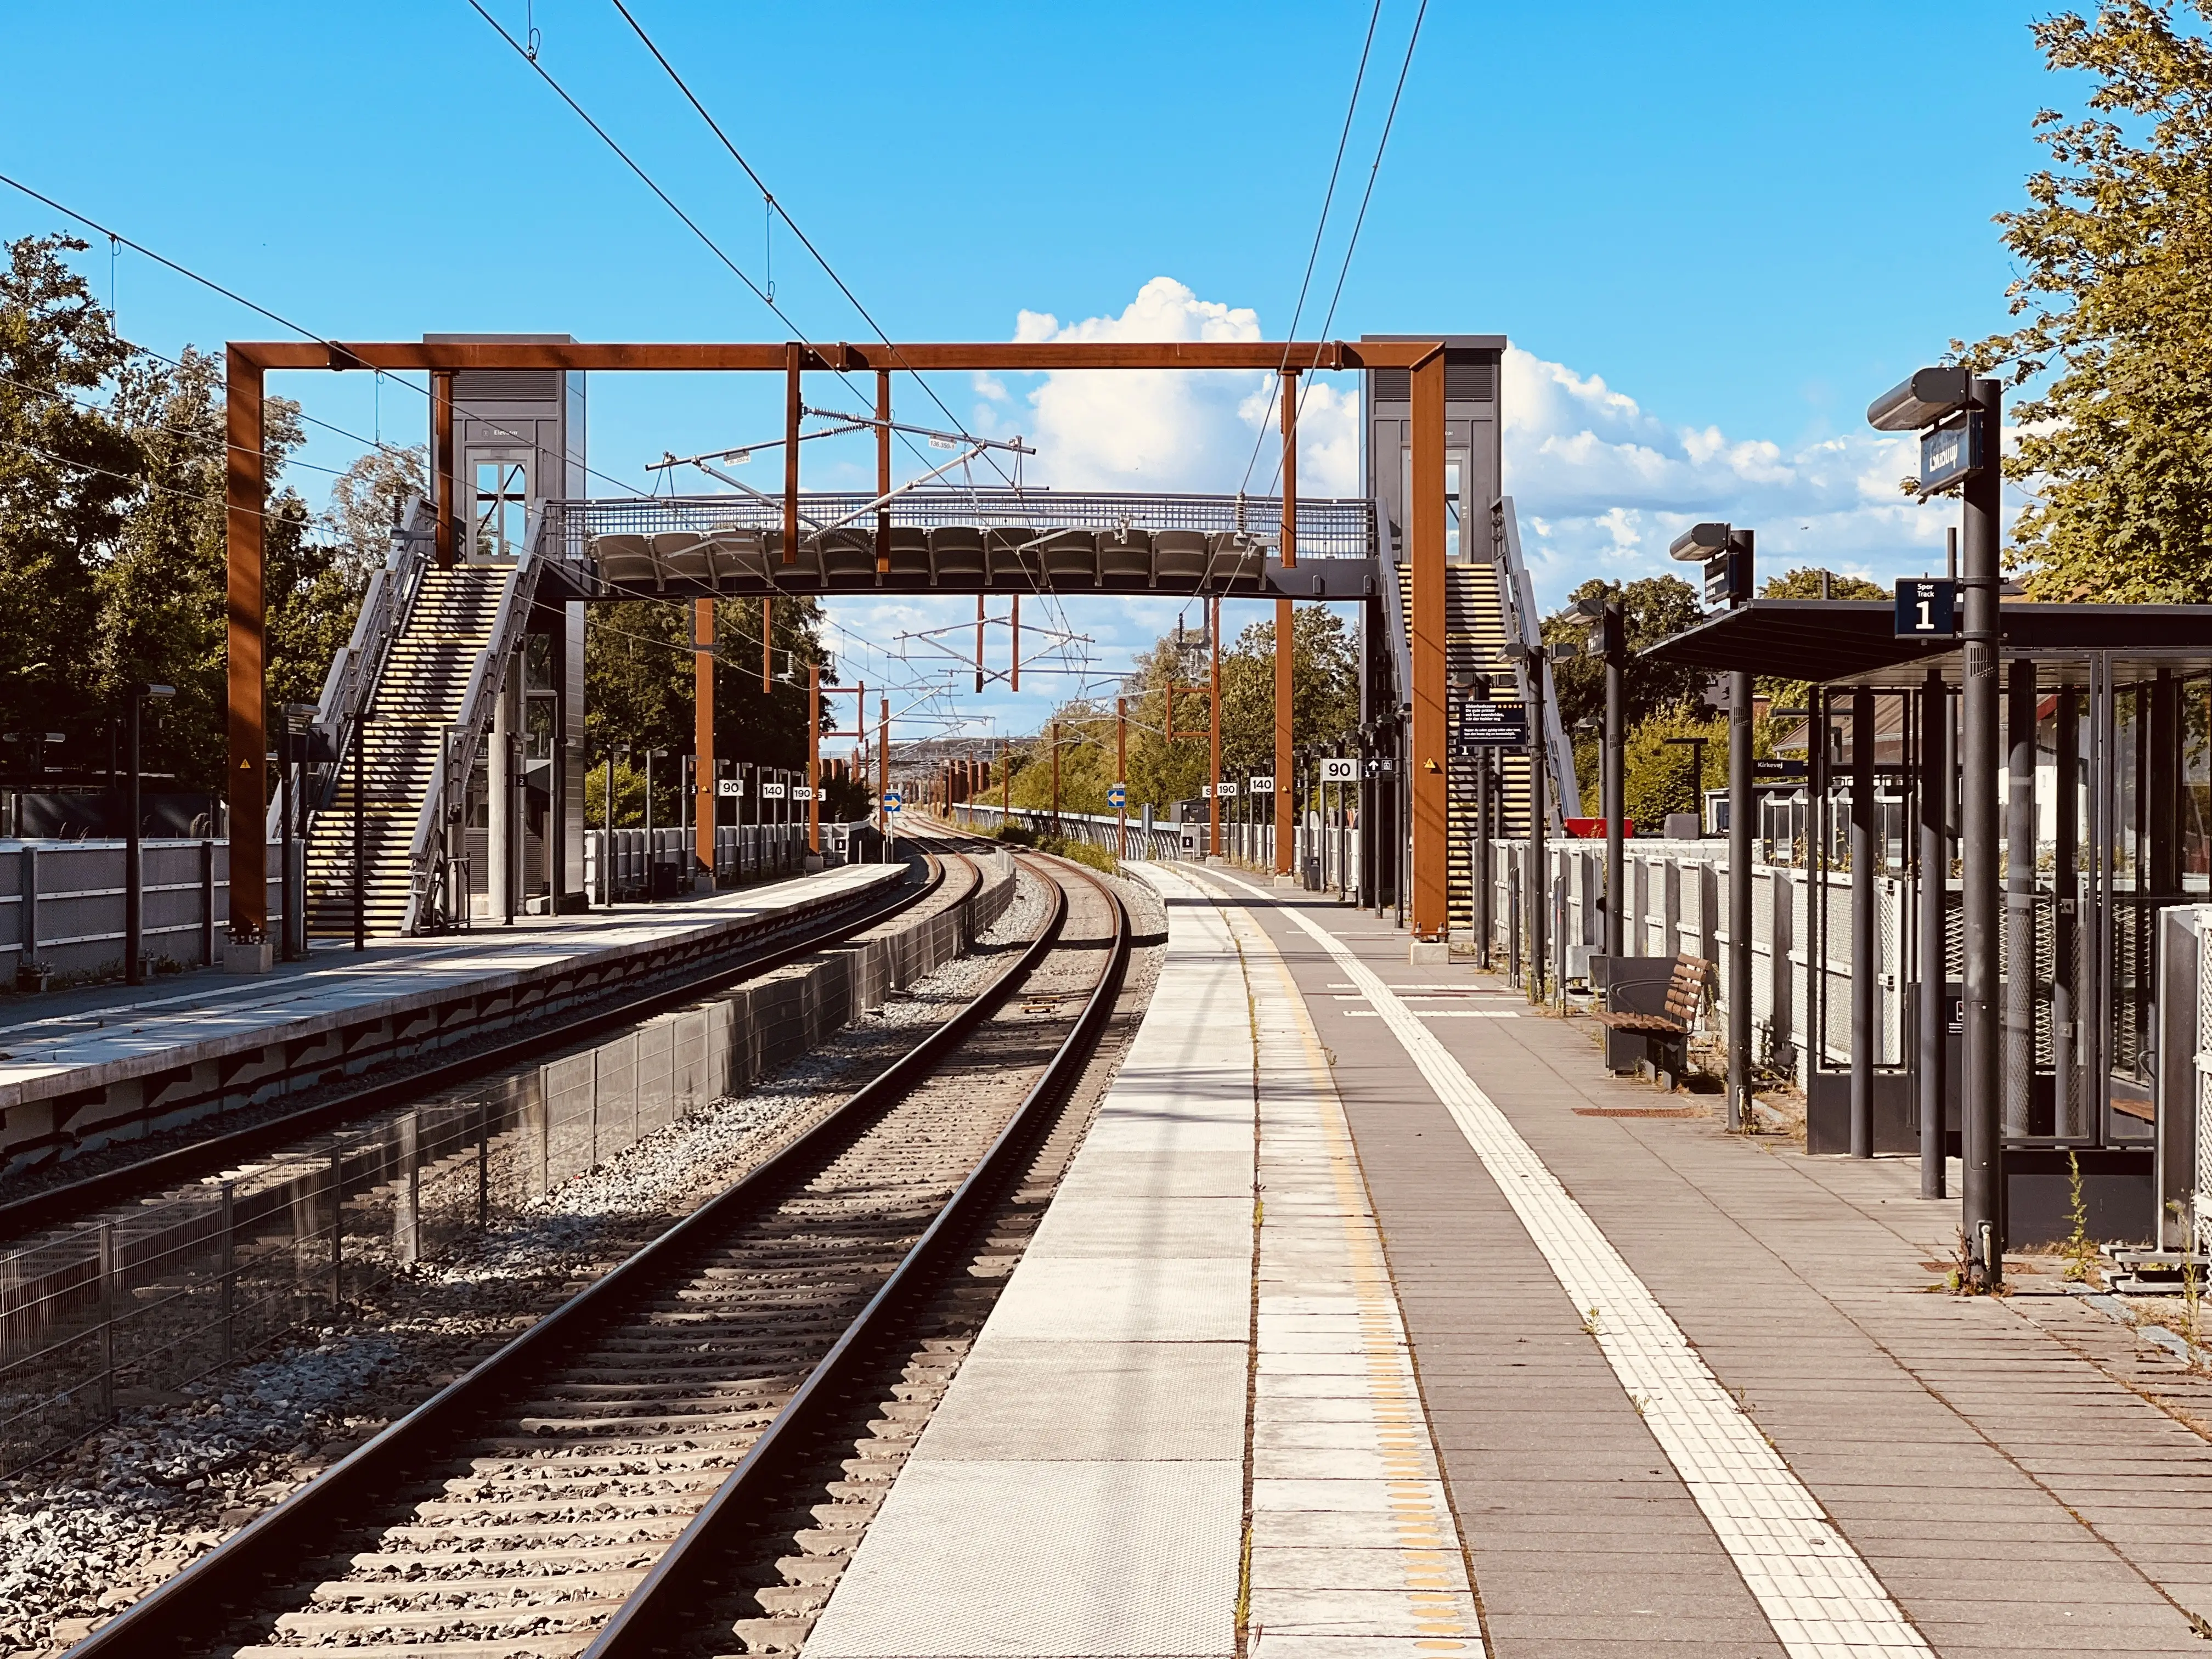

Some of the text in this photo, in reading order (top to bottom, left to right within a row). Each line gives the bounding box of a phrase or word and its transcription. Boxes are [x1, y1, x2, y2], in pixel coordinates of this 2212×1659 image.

[1916, 601, 1934, 629] 1
[1329, 763, 1350, 776] 90
[723, 783, 739, 793] 90
[1252, 780, 1272, 789] 140
[764, 786, 782, 795] 140
[794, 789, 810, 798] 190
